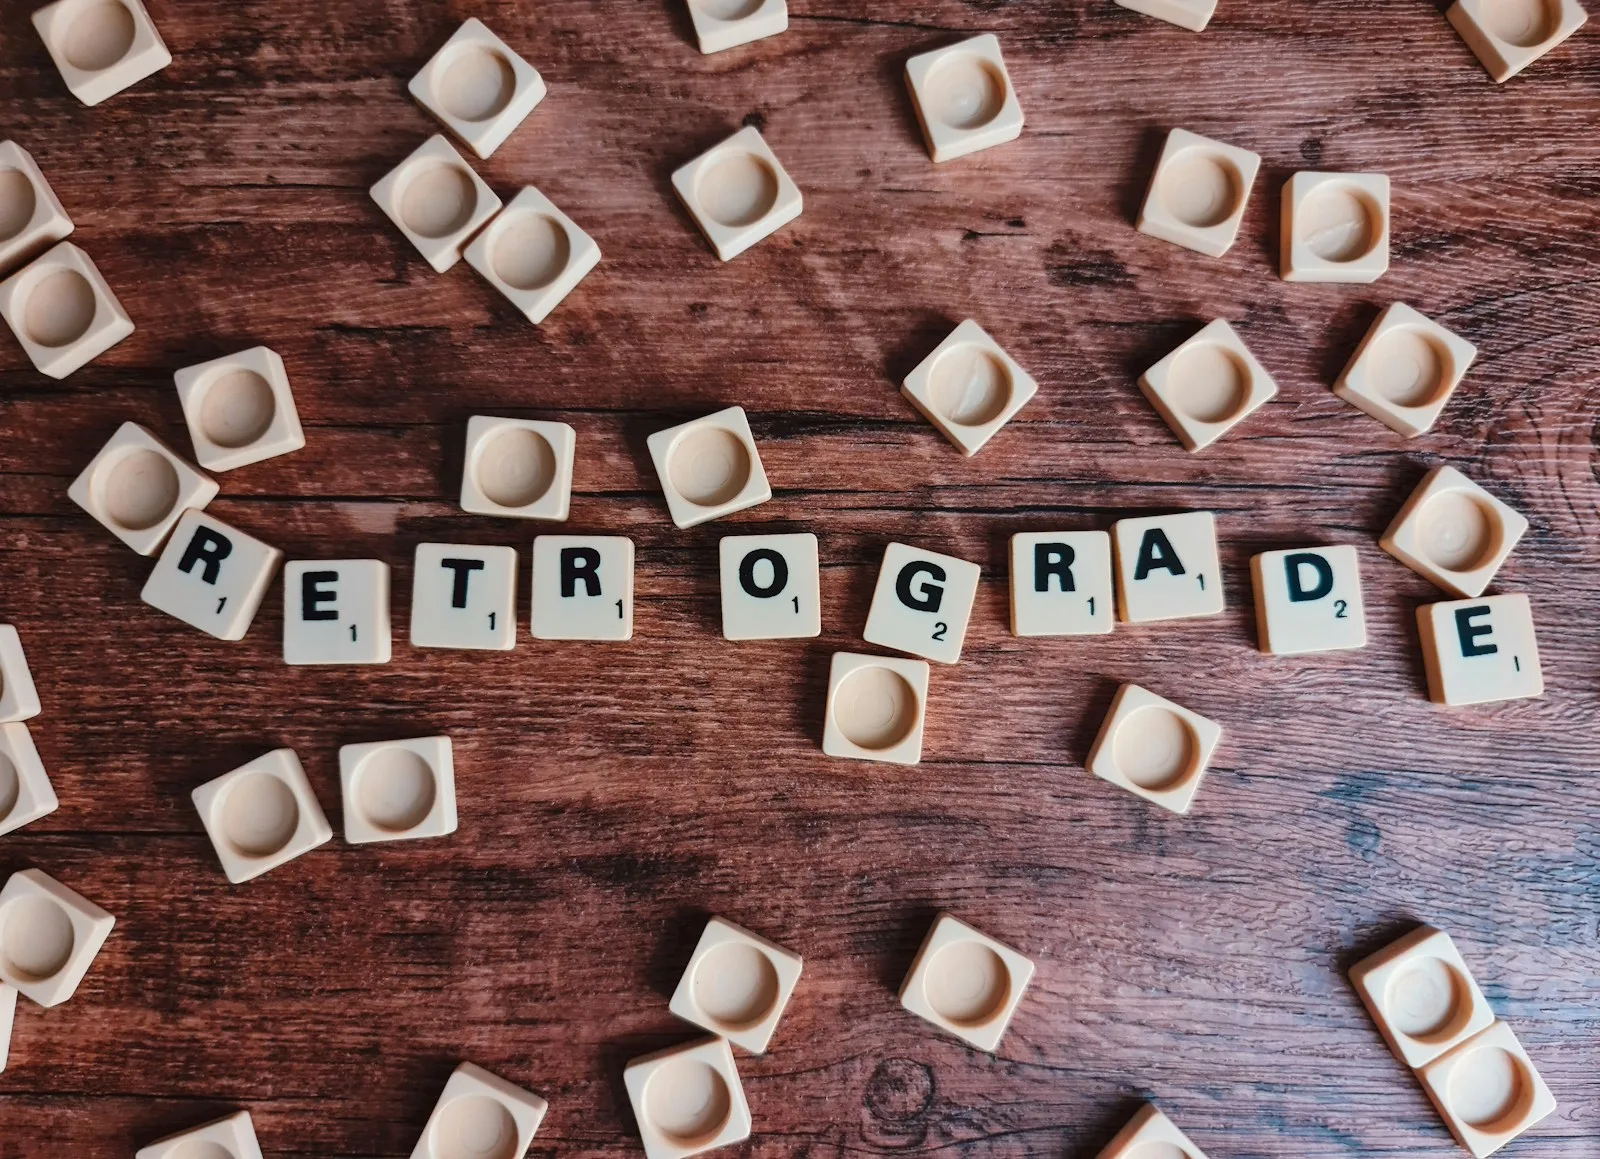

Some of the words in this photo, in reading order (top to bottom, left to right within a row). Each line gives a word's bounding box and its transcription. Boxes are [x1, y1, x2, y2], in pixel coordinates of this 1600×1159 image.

[176, 524, 234, 586] R
[300, 570, 340, 622] E
[440, 557, 485, 609] T
[559, 546, 603, 598] R
[738, 548, 789, 599] O
[895, 560, 947, 614] G
[1034, 542, 1076, 593] R
[1133, 527, 1186, 581] A
[1283, 552, 1334, 603] D
[1454, 605, 1499, 658] E
[1196, 573, 1205, 591] 1
[215, 596, 228, 615] 1
[615, 598, 624, 620] 1
[791, 595, 799, 614] 1
[1086, 596, 1095, 616] 1
[1333, 599, 1348, 619] 2
[487, 611, 497, 631] 1
[349, 623, 358, 643] 1
[931, 621, 948, 642] 2
